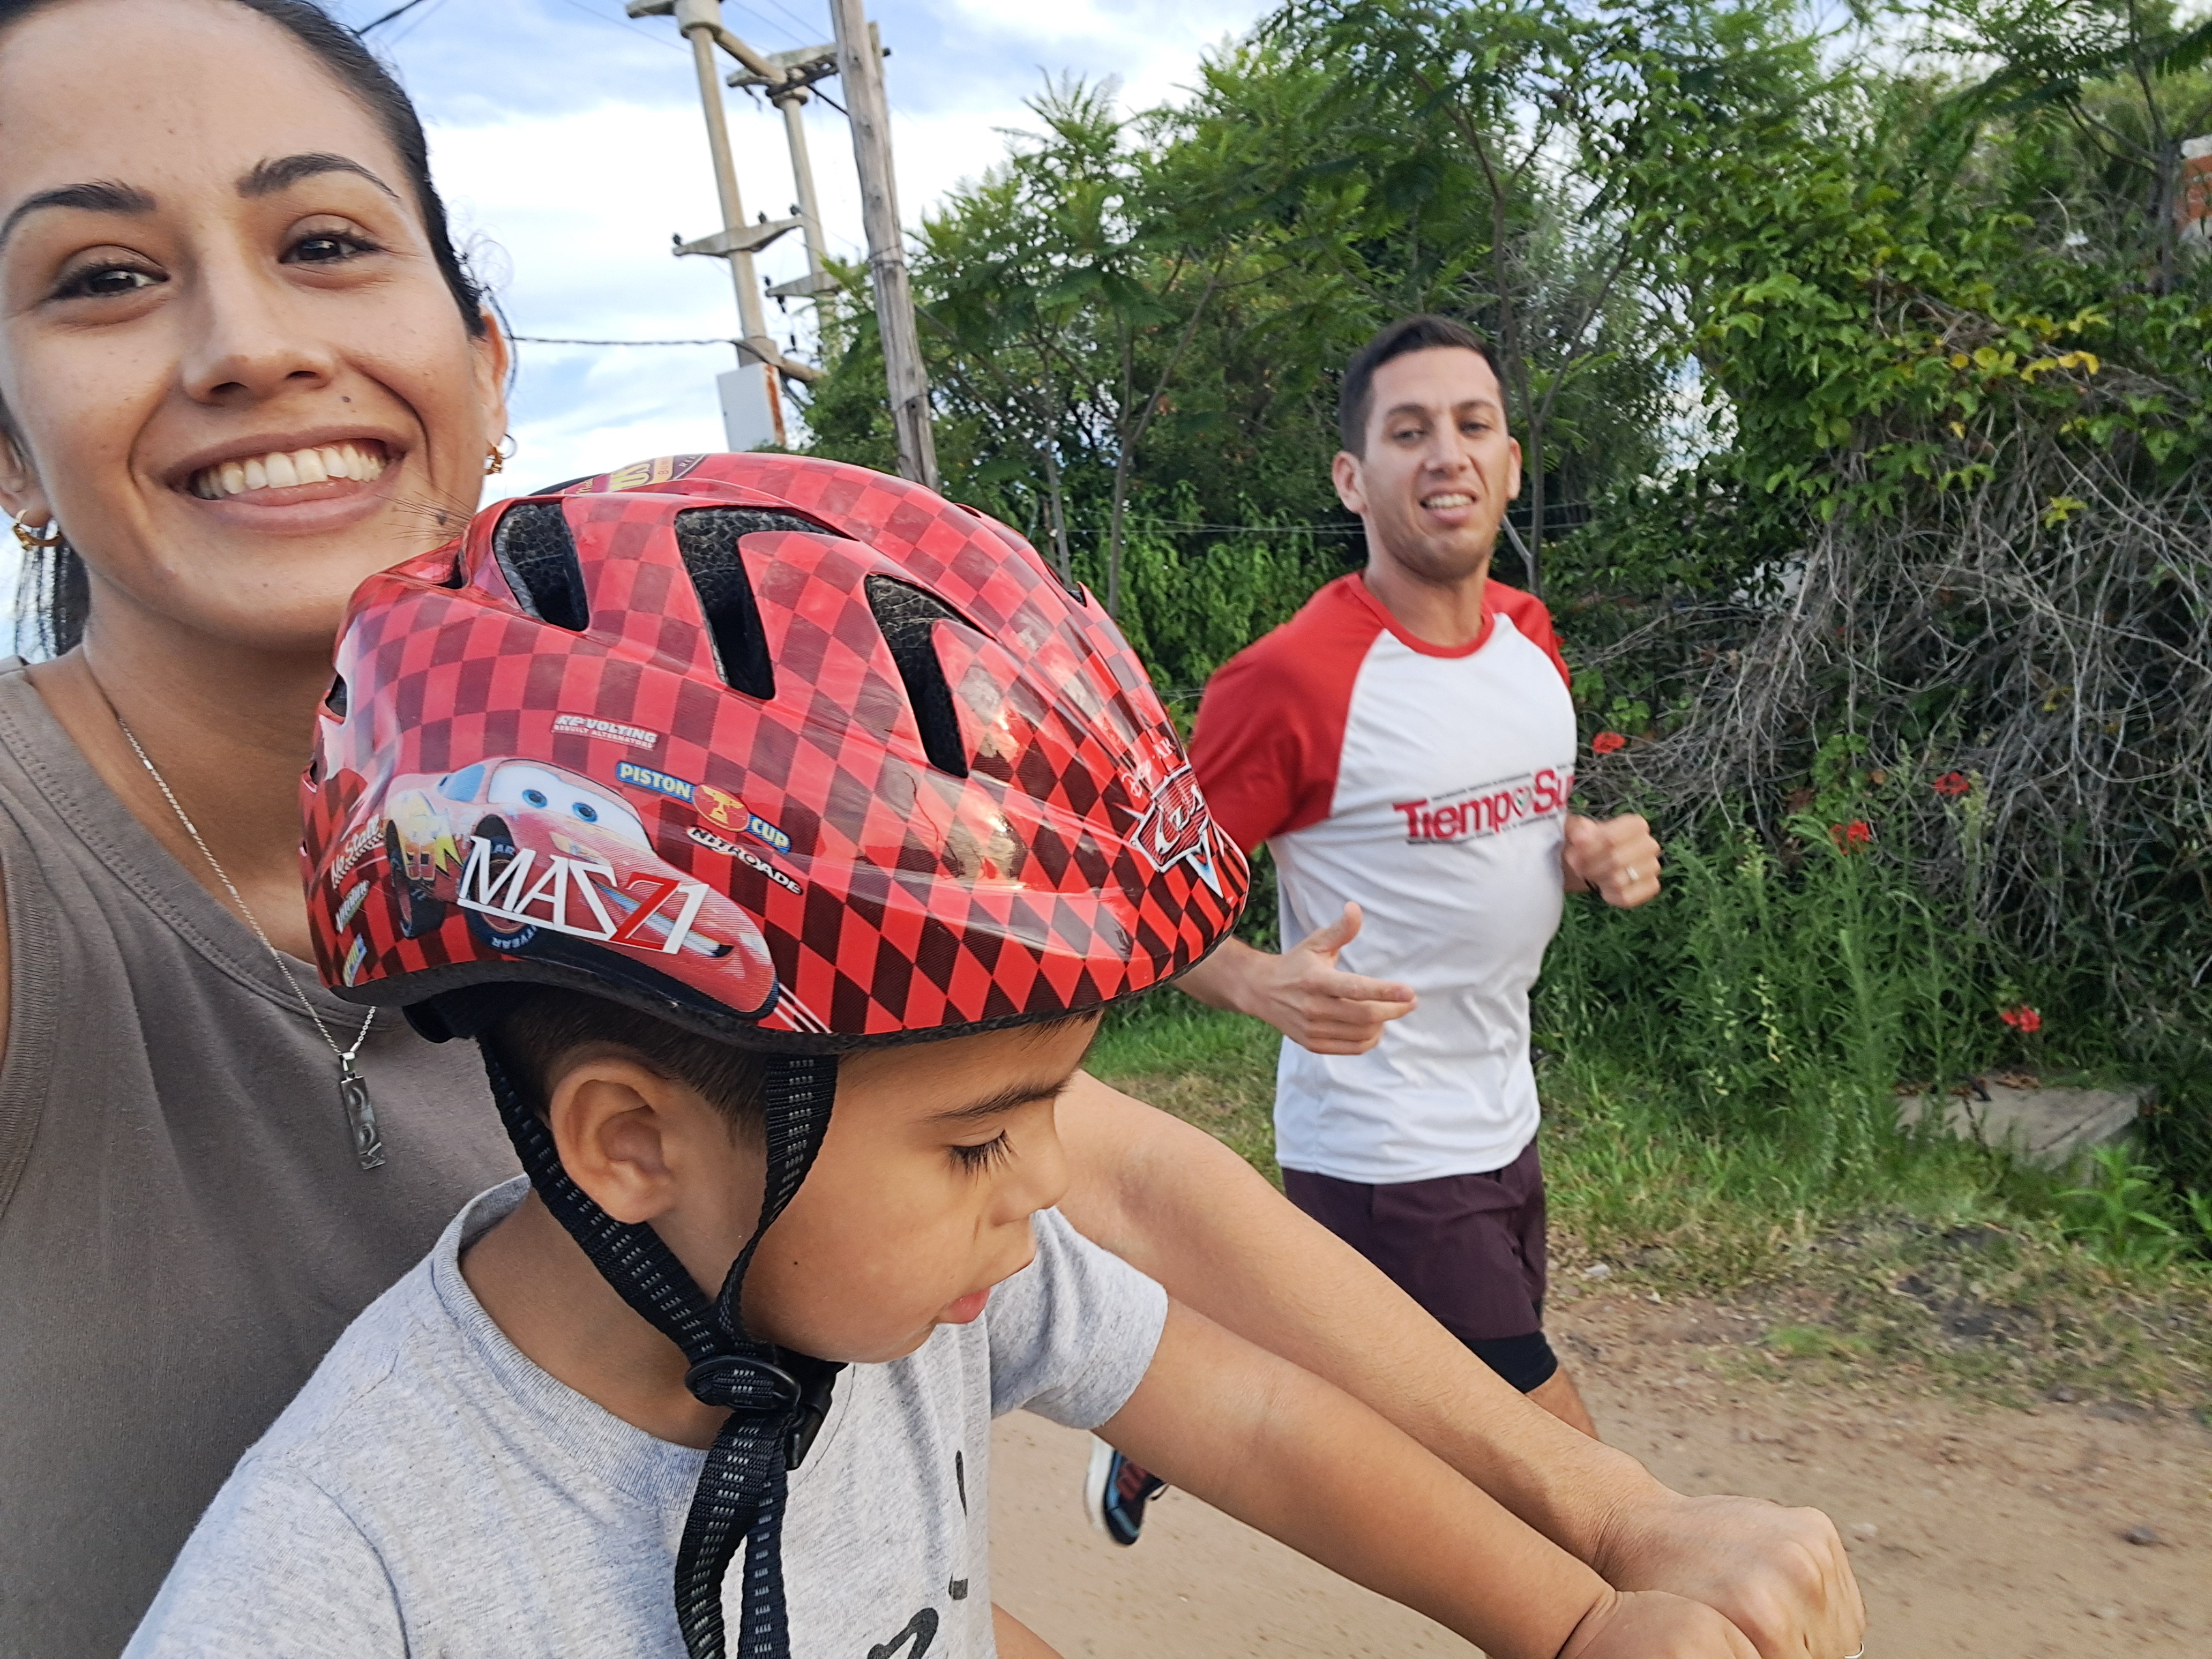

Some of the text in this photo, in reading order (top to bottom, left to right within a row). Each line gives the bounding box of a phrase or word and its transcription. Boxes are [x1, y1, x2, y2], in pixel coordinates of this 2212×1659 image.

[619, 763, 790, 848] PISTON CUP
[691, 828, 803, 894] NITROADE
